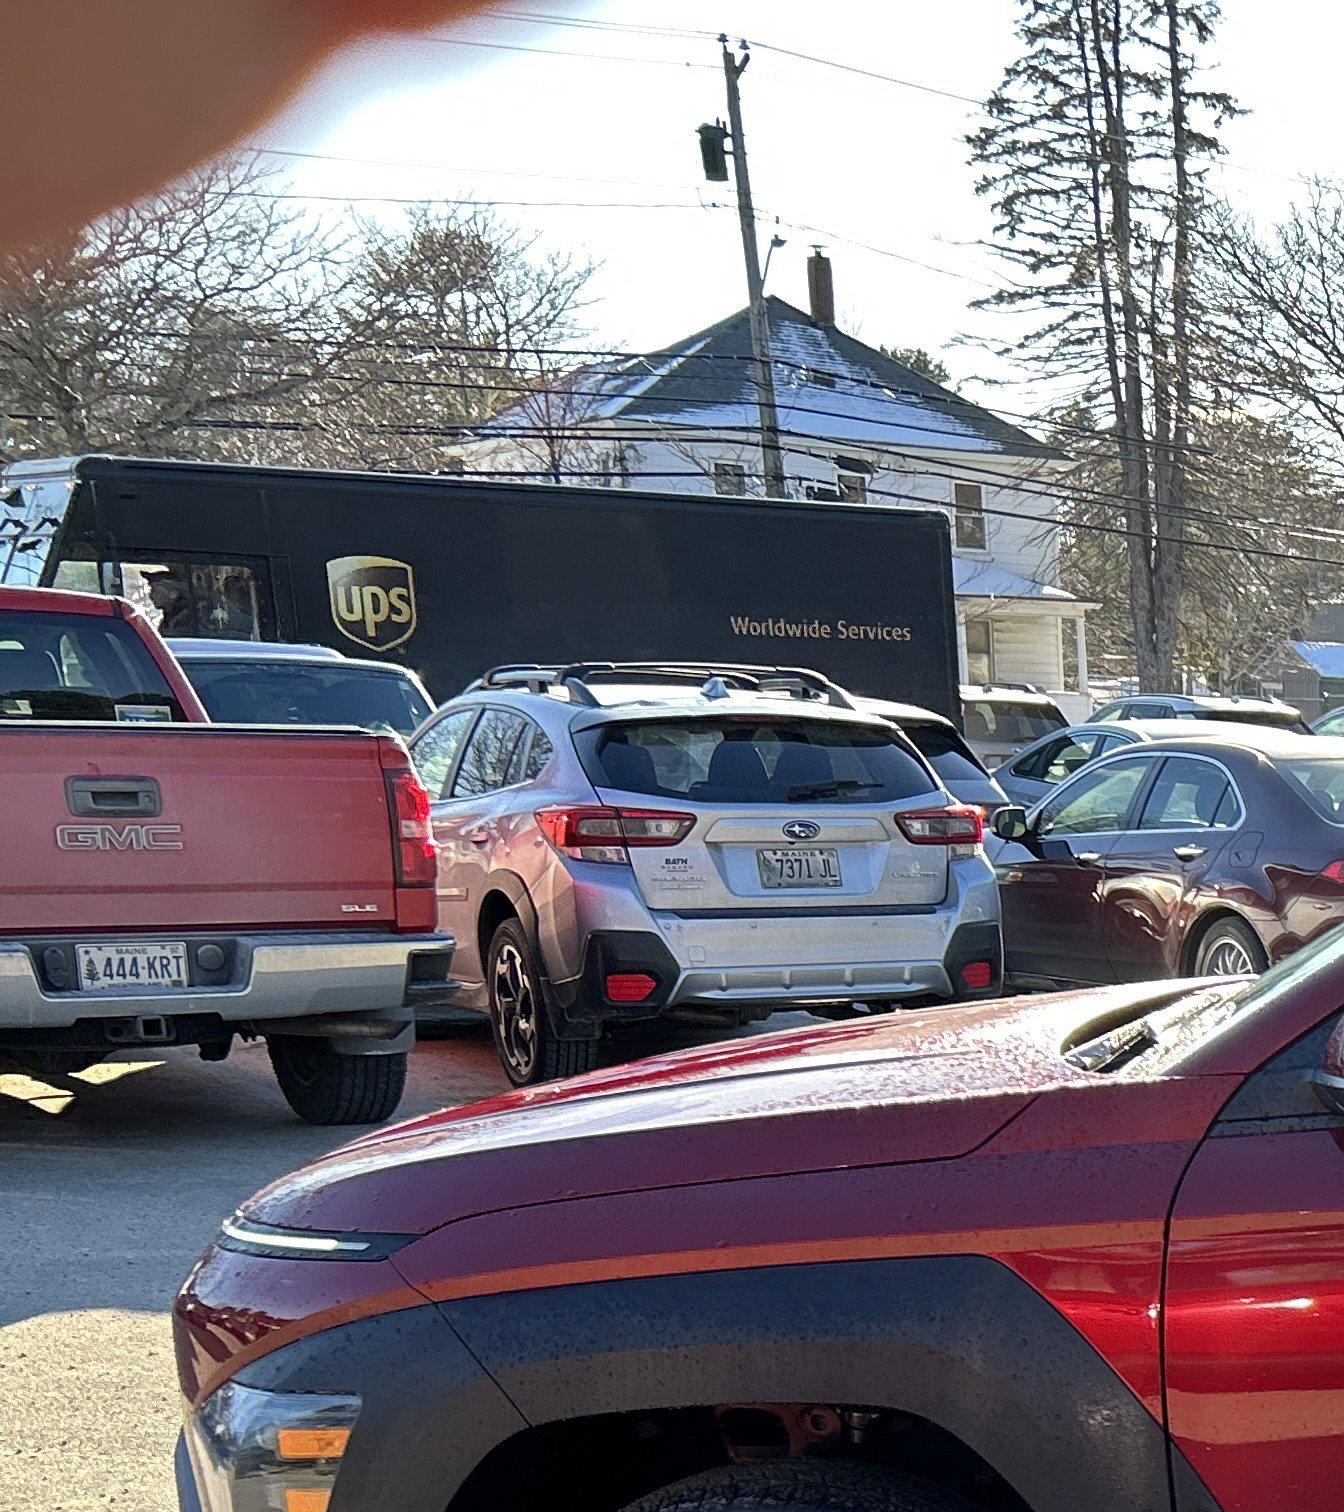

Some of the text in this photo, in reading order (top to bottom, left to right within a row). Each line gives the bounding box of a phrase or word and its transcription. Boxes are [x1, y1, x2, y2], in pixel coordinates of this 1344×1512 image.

[337, 585, 411, 637] ups
[730, 615, 912, 641] Worldwide Services
[56, 825, 183, 850] GMC
[664, 857, 689, 865] BATH
[775, 858, 838, 879] 7371 JL
[115, 947, 148, 955] MAINE
